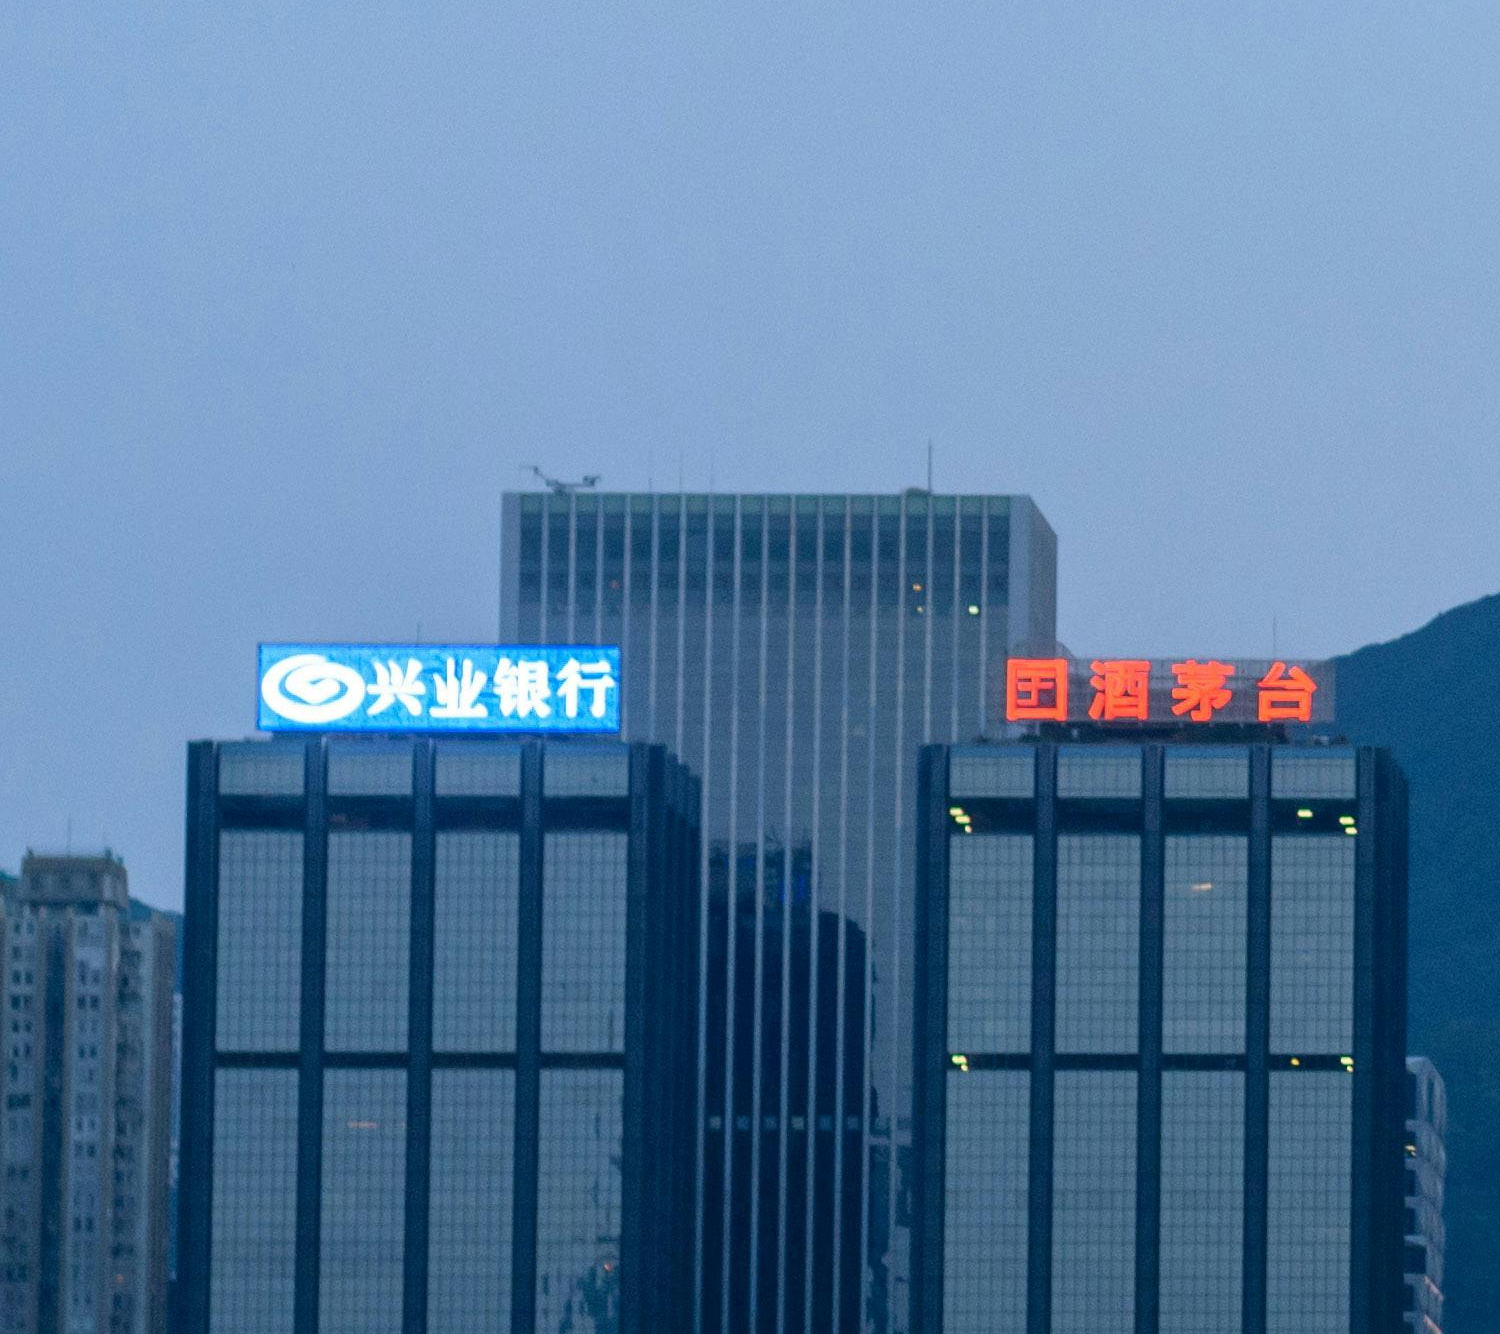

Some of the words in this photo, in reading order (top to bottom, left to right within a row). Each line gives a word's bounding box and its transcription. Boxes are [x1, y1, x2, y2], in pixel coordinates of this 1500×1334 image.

[366, 657, 616, 719] 兴业银行
[1006, 658, 1317, 722] 国酒茅台
